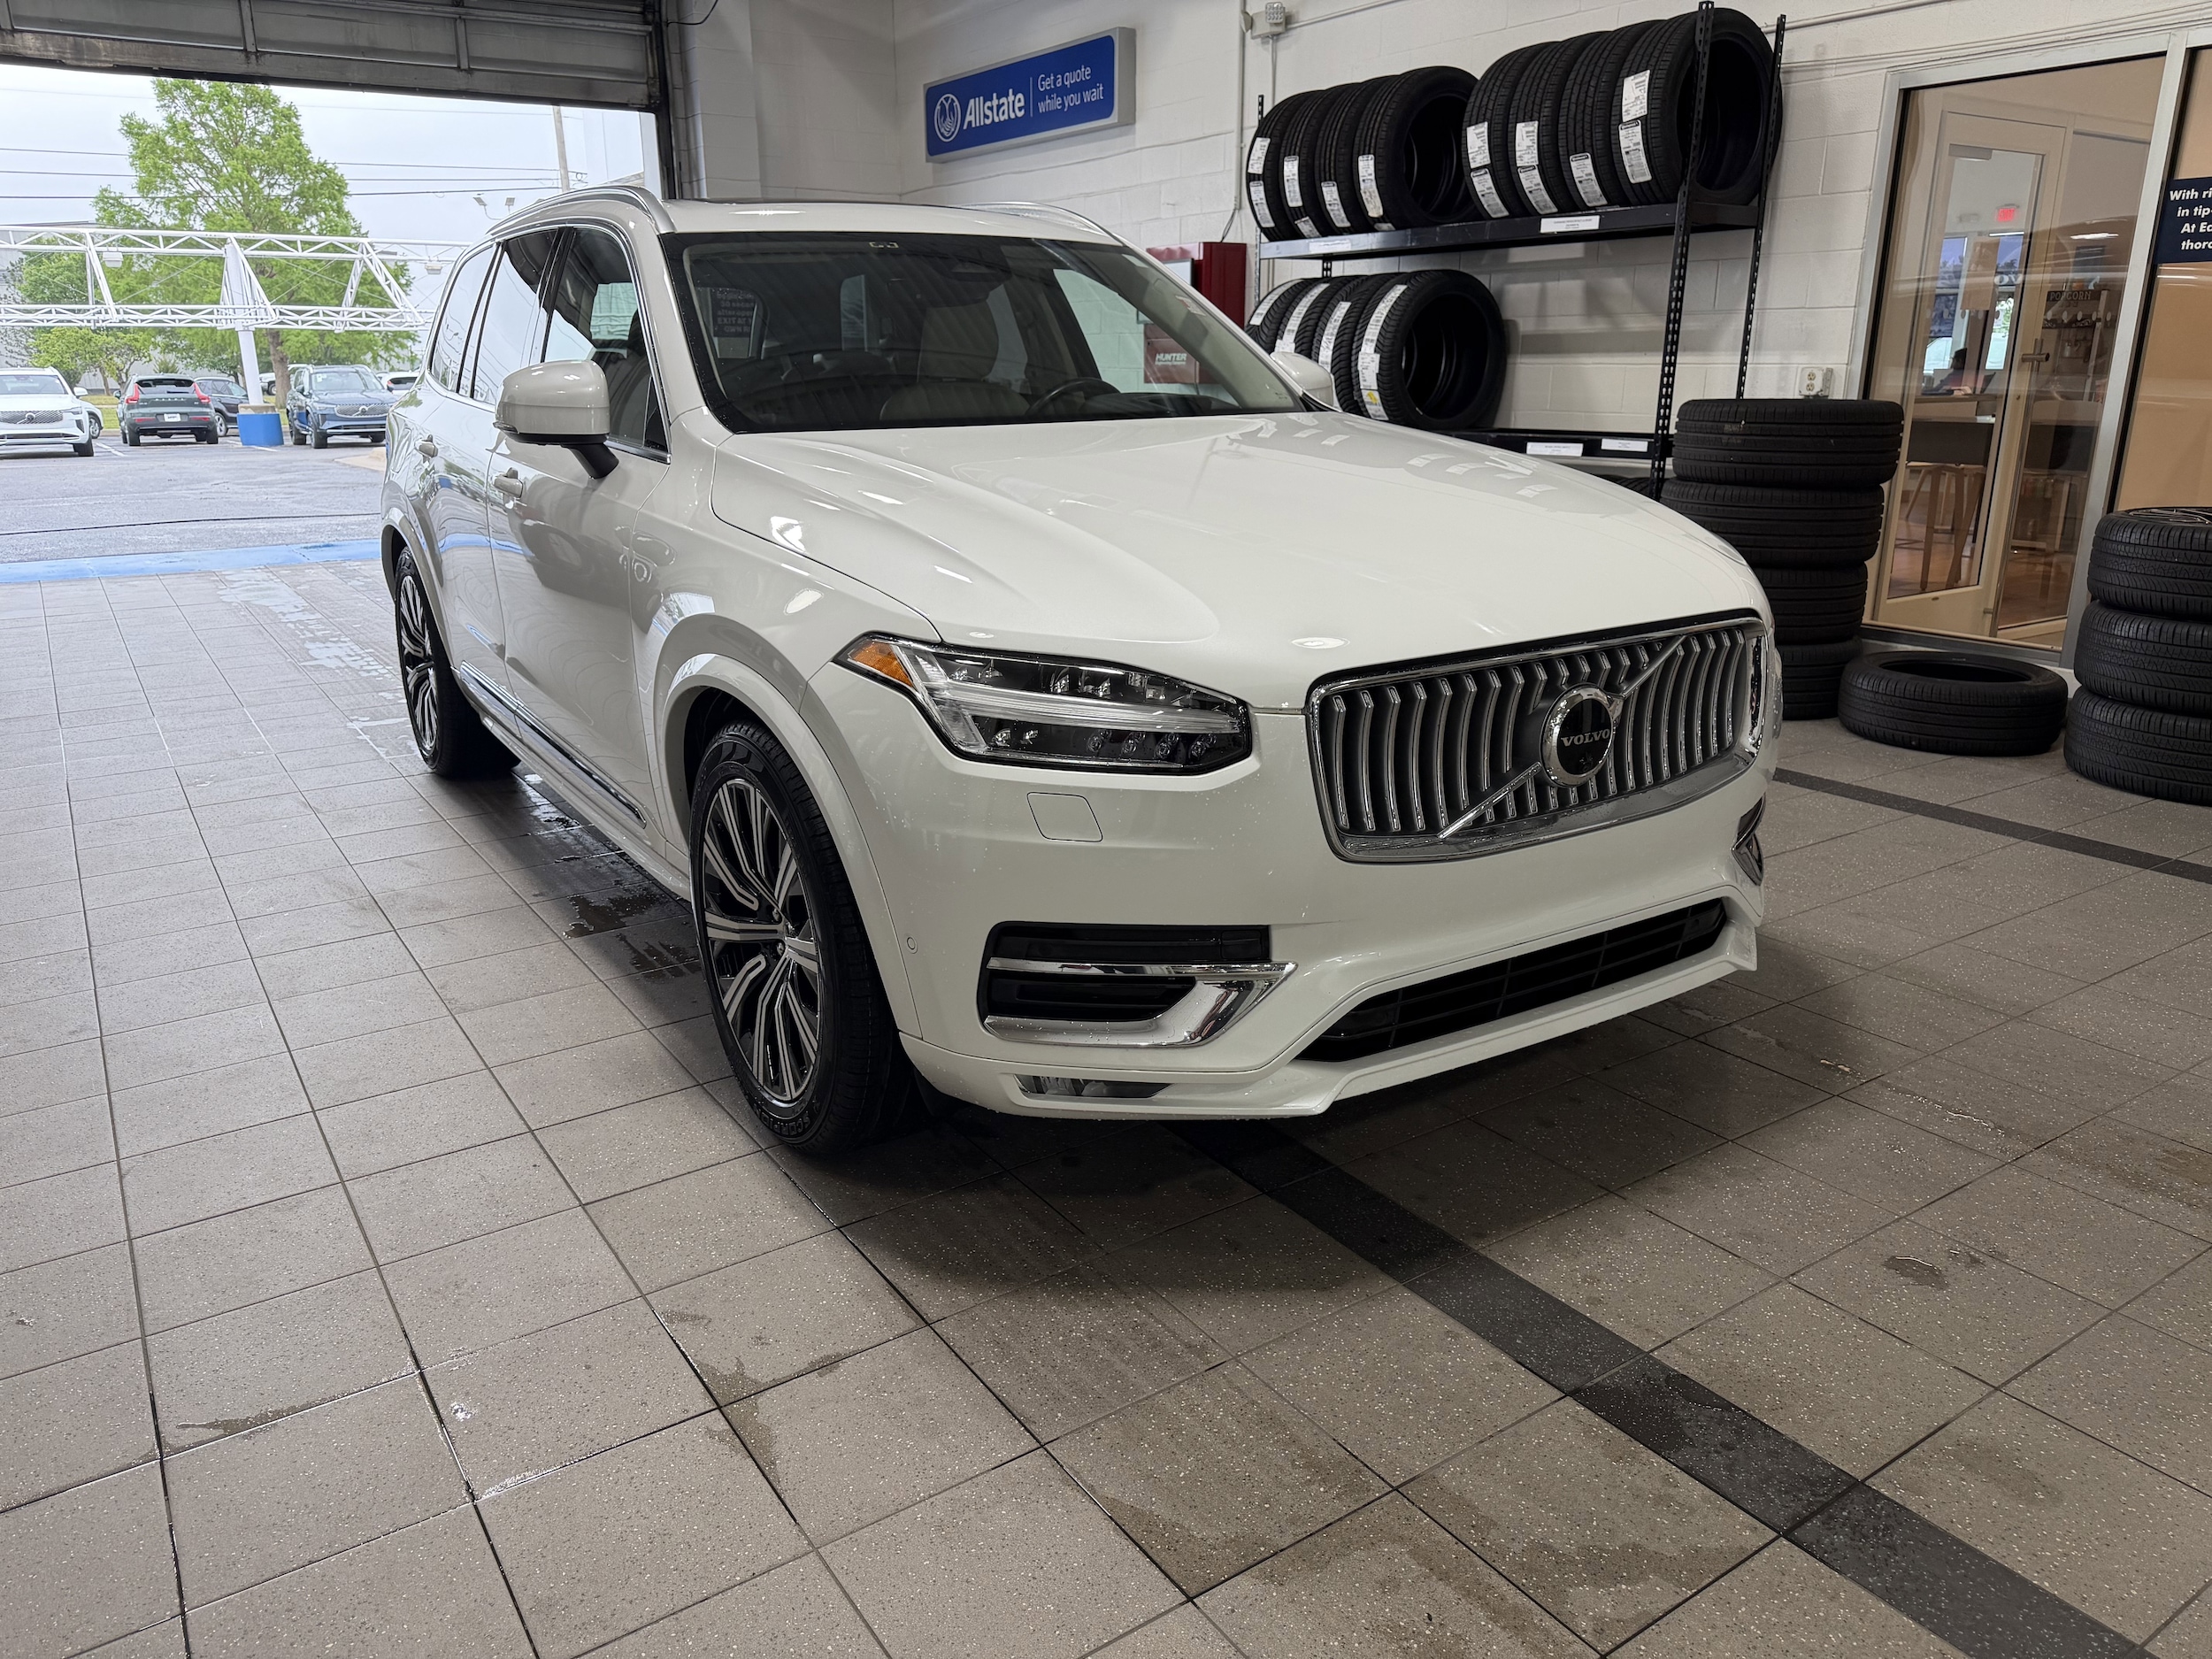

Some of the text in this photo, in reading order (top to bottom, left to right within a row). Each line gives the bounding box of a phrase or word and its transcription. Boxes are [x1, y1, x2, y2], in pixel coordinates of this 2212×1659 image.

[1038, 65, 1091, 91] Get a quote
[1038, 83, 1103, 113] while you wait
[963, 88, 1025, 129] Allstate
[2170, 188, 2199, 201] With
[2177, 206, 2189, 217] in
[2180, 223, 2196, 234] At
[1561, 729, 1610, 747] VOLVO
